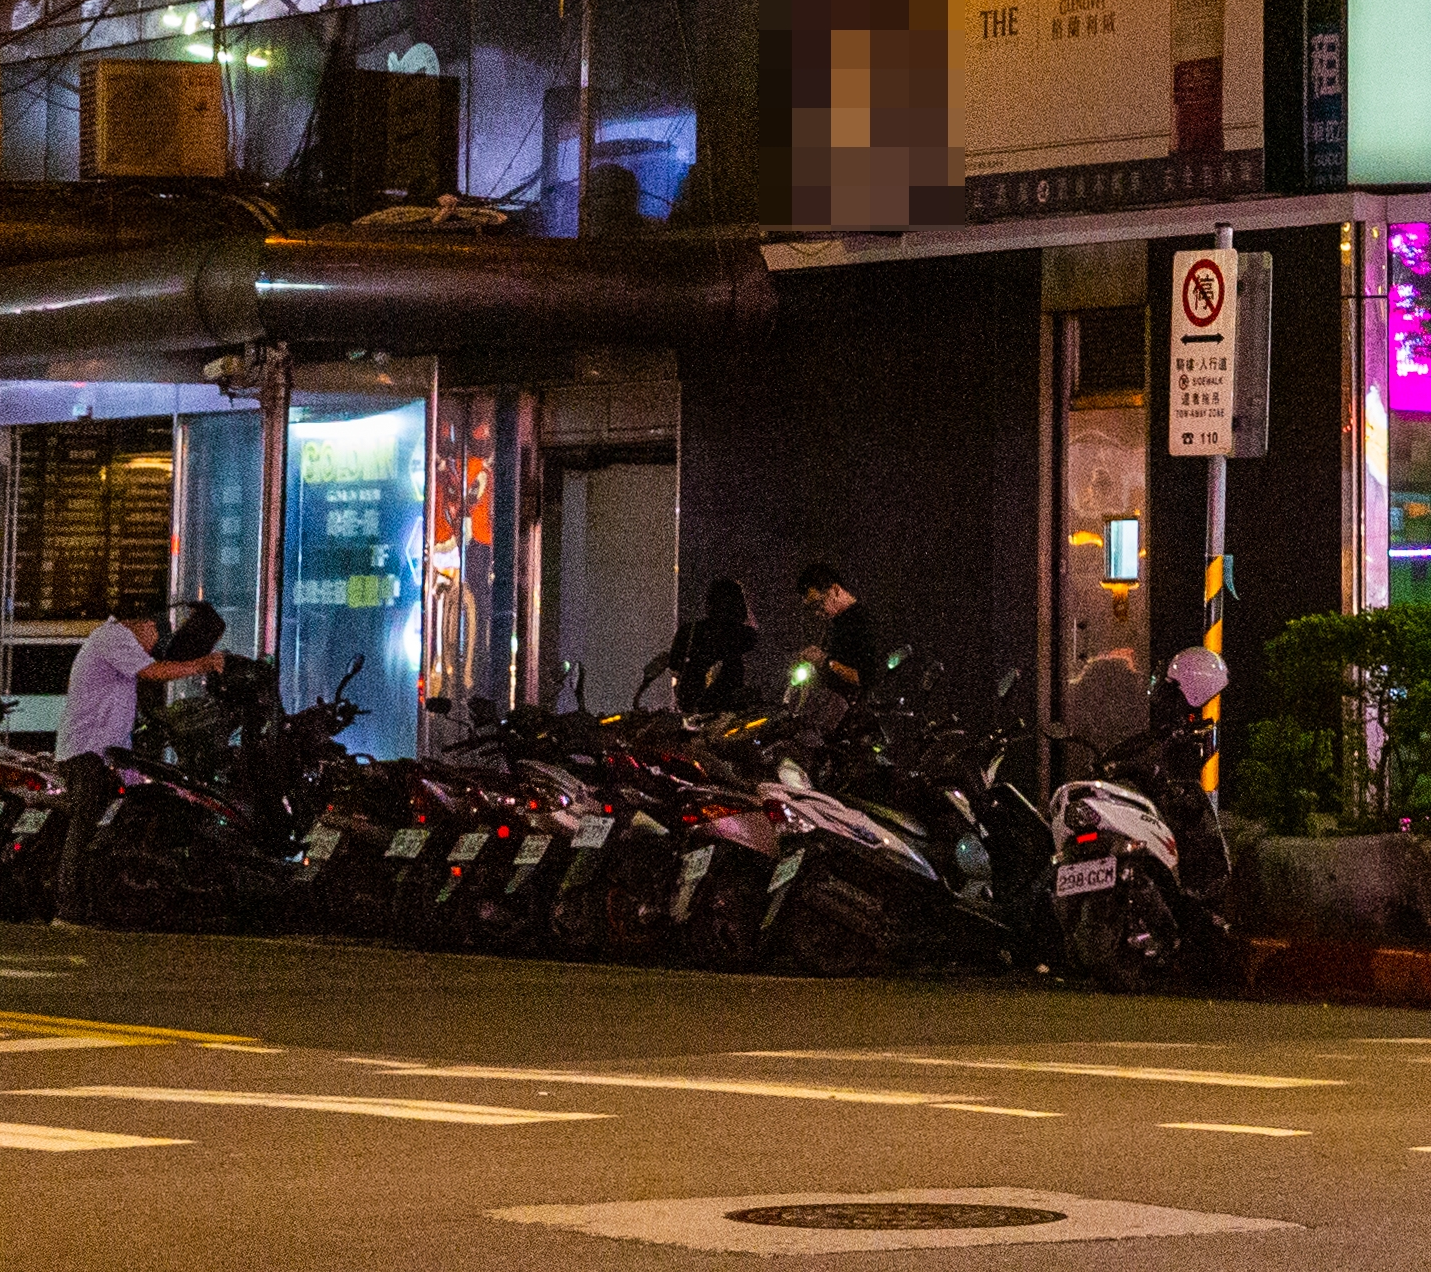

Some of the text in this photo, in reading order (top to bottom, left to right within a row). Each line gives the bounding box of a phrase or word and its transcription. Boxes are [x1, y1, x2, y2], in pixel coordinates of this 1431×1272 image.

[979, 6, 1019, 40] THE
[1191, 274, 1216, 312] 停
[1192, 375, 1224, 387] SIDEWALK
[1200, 430, 1219, 446] 110
